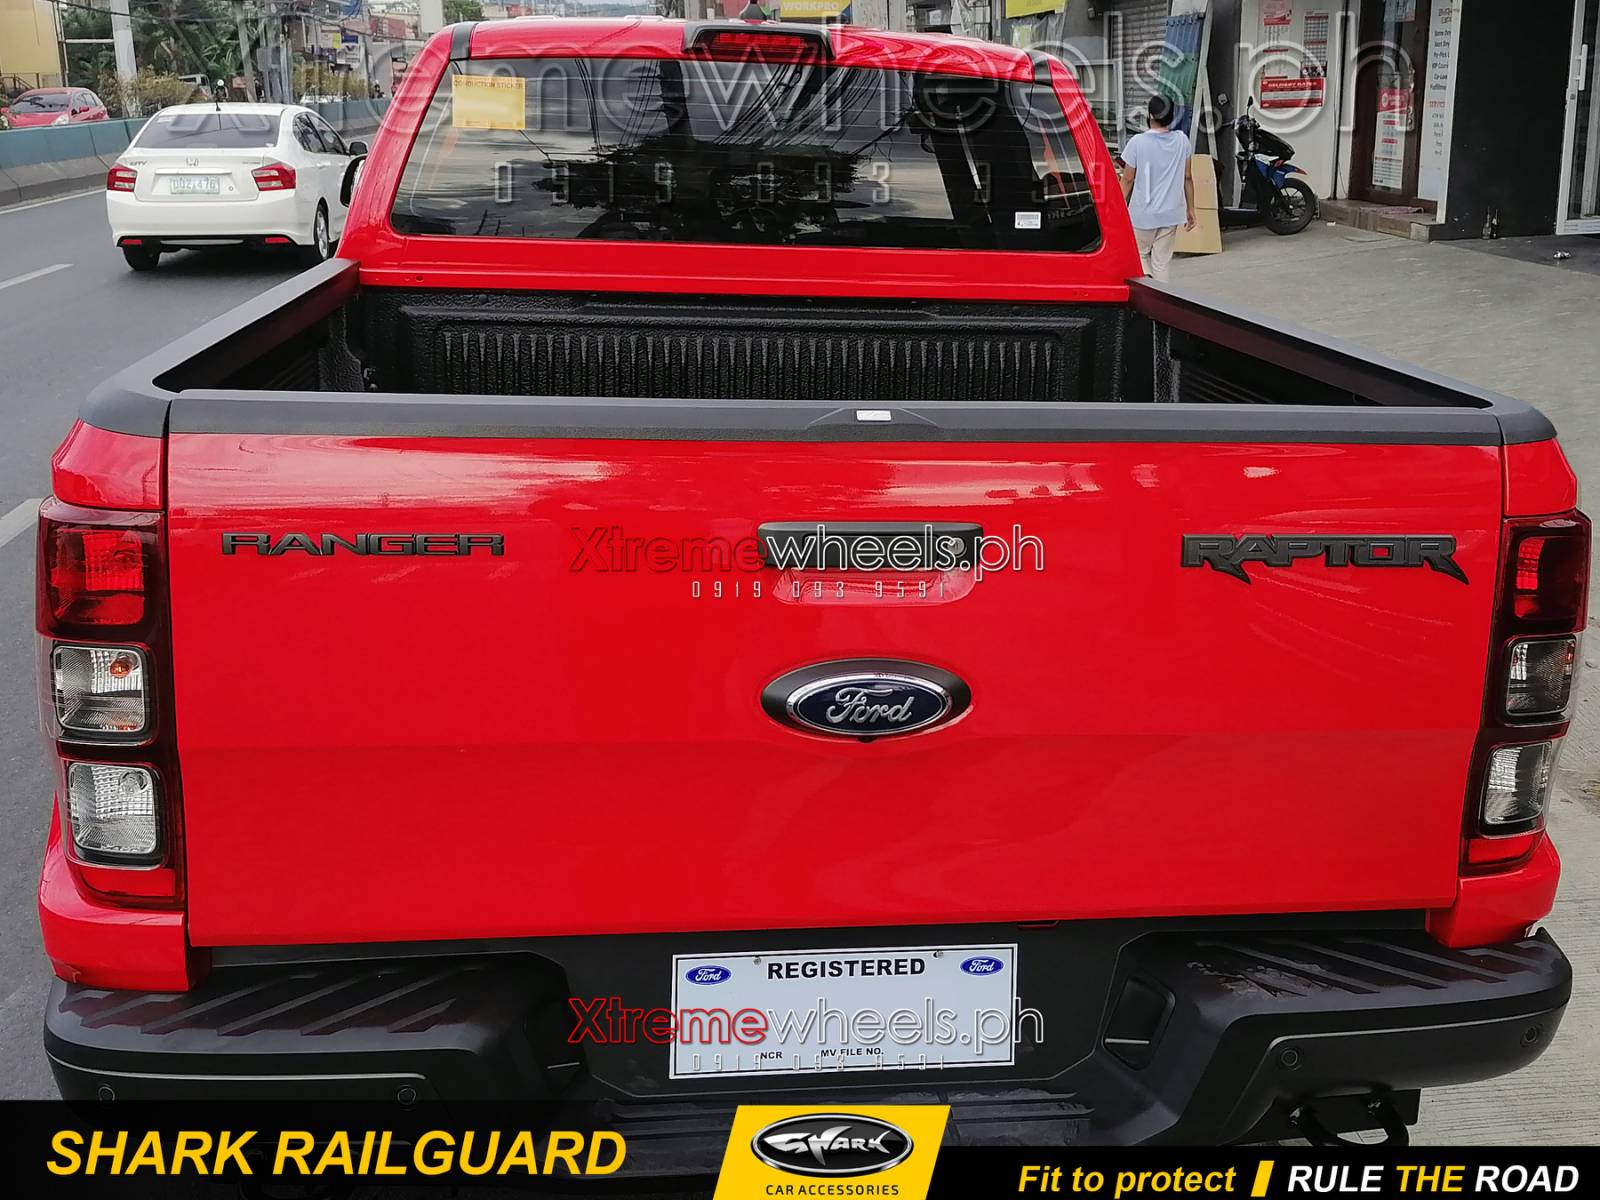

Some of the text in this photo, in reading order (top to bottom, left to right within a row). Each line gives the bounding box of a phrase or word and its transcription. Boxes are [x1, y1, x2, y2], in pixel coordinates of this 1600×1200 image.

[221, 531, 506, 556] RANGER
[1180, 533, 1470, 585] RAPTOR
[825, 686, 914, 724] Ford
[694, 967, 722, 982] Ford
[767, 957, 926, 980] REGISTERED
[968, 958, 995, 974] Ford
[759, 1051, 784, 1060] NCR
[820, 1047, 885, 1058] MV FILE NO.
